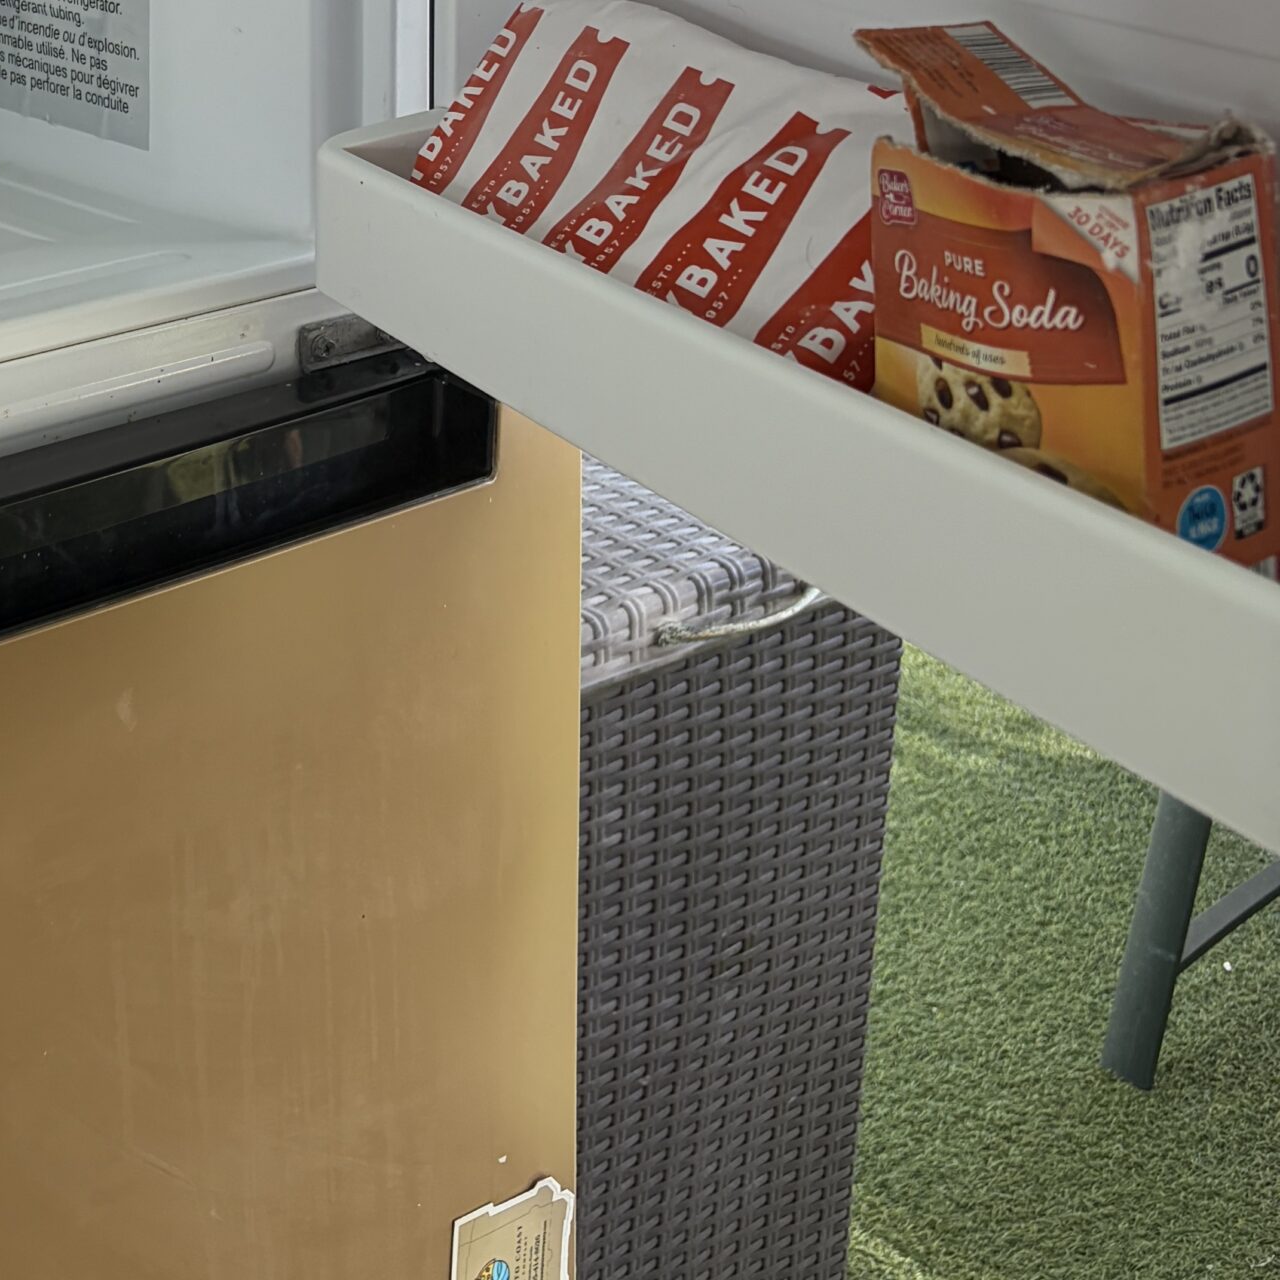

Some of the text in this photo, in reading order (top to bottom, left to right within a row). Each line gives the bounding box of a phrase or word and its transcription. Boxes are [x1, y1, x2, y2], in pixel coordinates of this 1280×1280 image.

[49, 4, 85, 28] tubing.
[62, 30, 76, 45] ou
[71, 47, 87, 66] Ne
[89, 55, 108, 72] pas
[9, 70, 27, 87] pas
[29, 76, 70, 98] perforer
[72, 84, 82, 101] la
[84, 90, 129, 114] conduite
[70, 68, 95, 86] pour
[96, 73, 140, 99] dégivrer
[495, 59, 598, 208] BAKED
[575, 101, 702, 247] BAKED
[881, 200, 914, 220] Corner
[1214, 181, 1253, 212] Facts
[674, 144, 809, 300] BAKED
[1067, 205, 1091, 227] 30
[1087, 222, 1131, 259] DAYS
[943, 250, 986, 276] PURE
[894, 249, 1084, 332] Baking Soda
